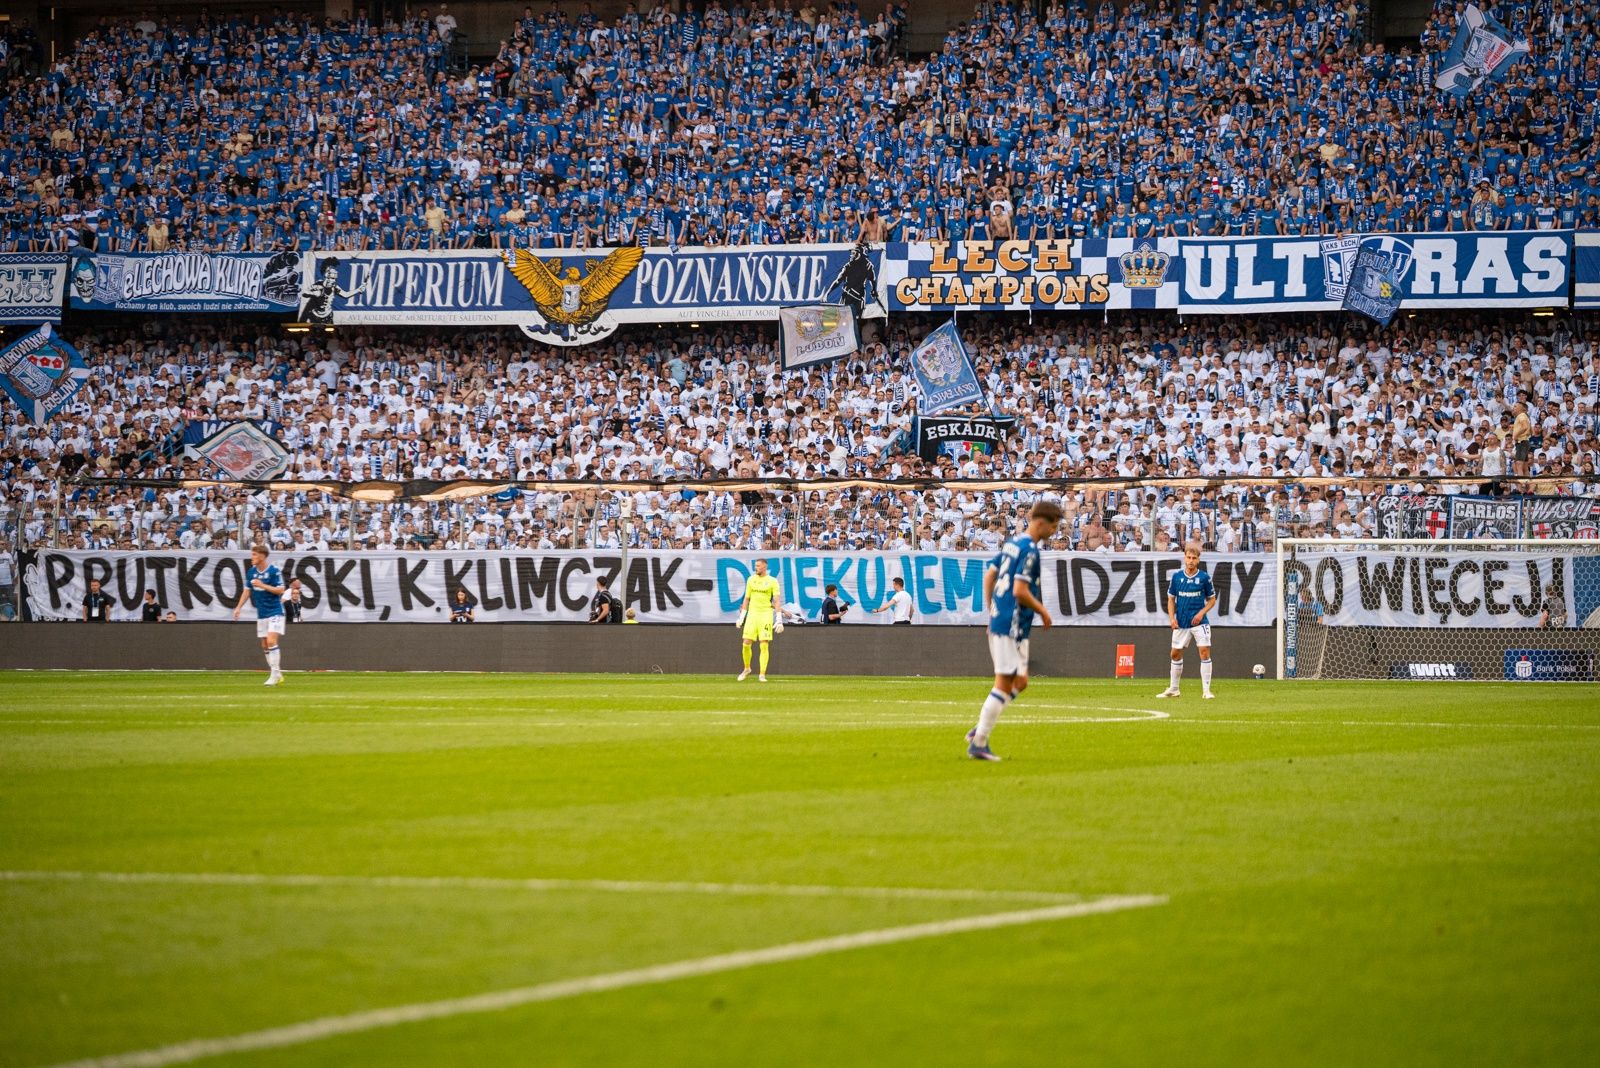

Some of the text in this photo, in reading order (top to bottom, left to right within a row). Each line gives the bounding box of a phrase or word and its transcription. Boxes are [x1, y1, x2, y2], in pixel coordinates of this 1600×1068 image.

[1340, 239, 1356, 248] LECH
[929, 239, 1073, 272] LECH
[214, 256, 261, 299] KLIKA
[345, 252, 828, 308] IMPERIUM POZNAŃSKIE
[895, 273, 1110, 305] CHAMPIONS
[1331, 287, 1346, 295] POZ
[115, 301, 146, 310] Kochamy
[203, 302, 220, 310] ludzi
[233, 302, 270, 311] zdradzimy
[1455, 502, 1516, 520] CARLOS
[83, 555, 391, 621] RUTKOSKI,
[716, 554, 994, 618] DIĘKUJEM
[1056, 557, 1264, 616] IDZIEMY
[1287, 603, 1296, 620] LECH
[1536, 664, 1554, 672] Bank
